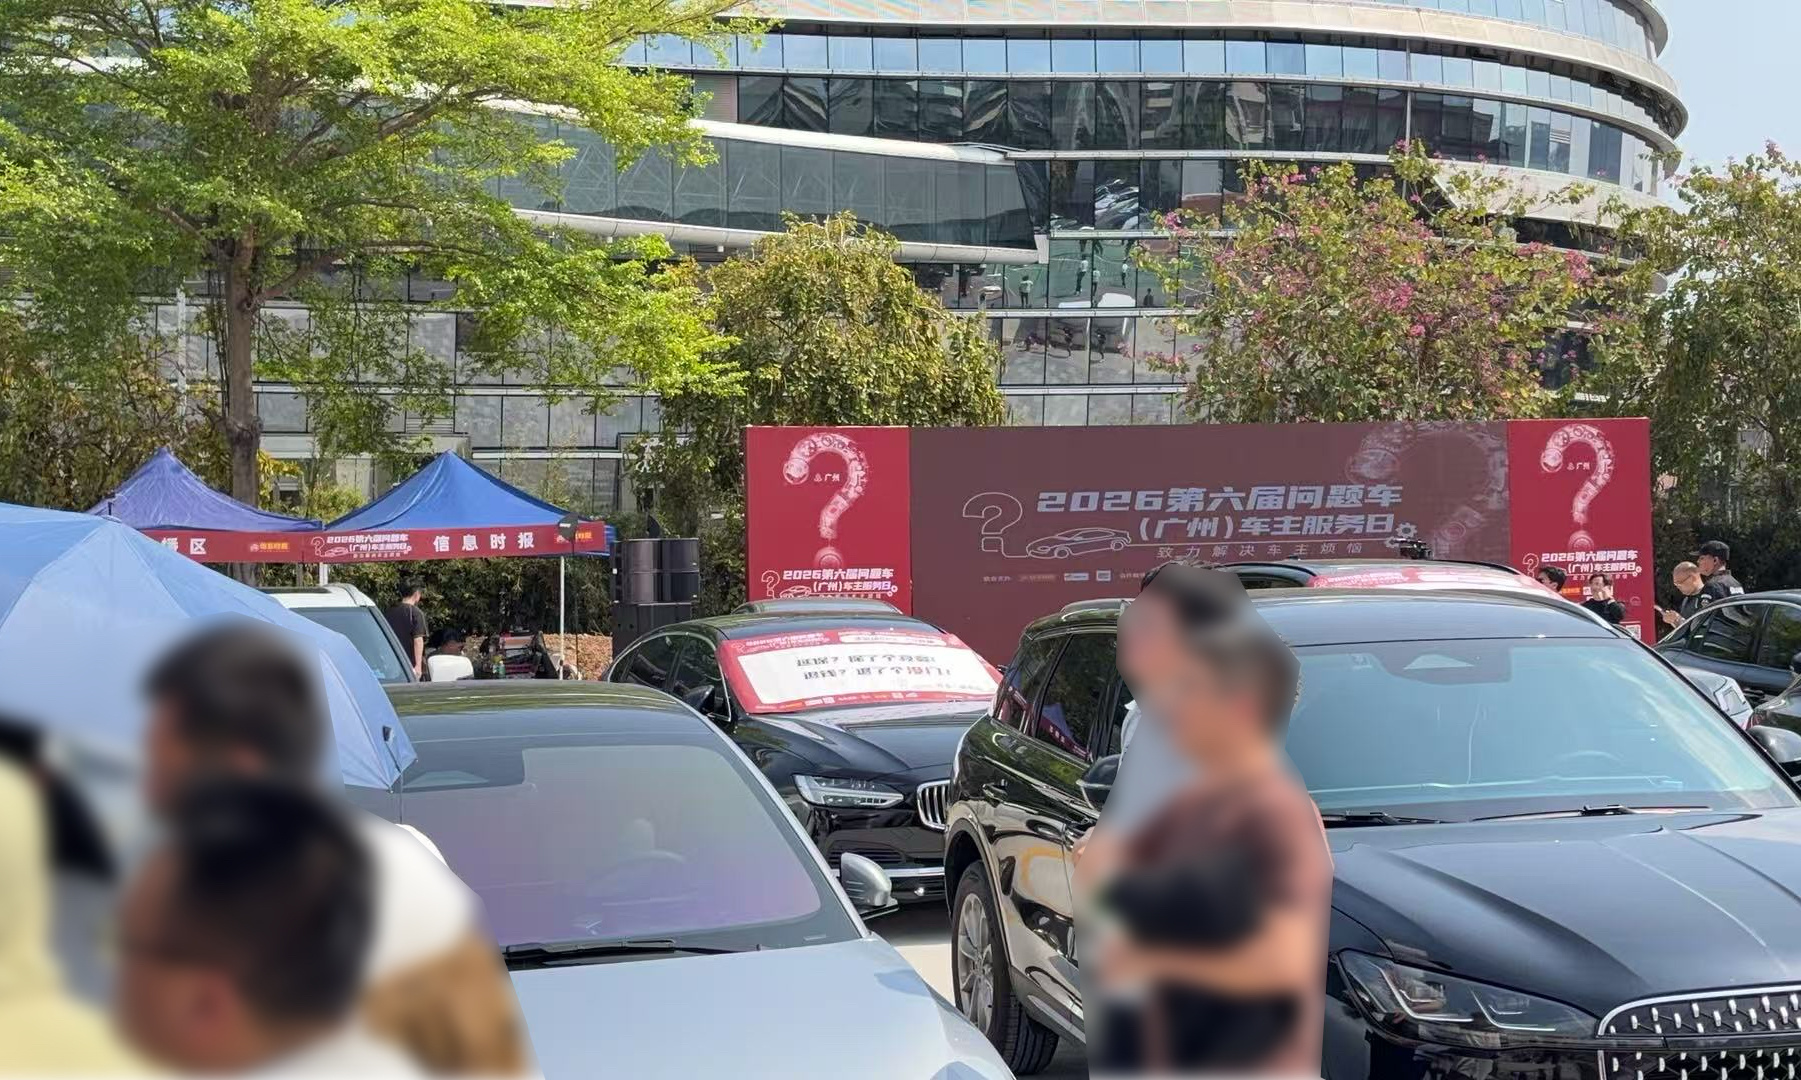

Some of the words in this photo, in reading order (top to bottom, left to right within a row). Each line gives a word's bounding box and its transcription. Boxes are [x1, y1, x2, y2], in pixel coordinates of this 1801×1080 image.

[1037, 483, 1403, 513] 2026第六届问题车
[1139, 513, 1394, 541] （广州）车主服务日
[433, 531, 534, 552] 信息时报
[1157, 542, 1363, 560] 致力解决车主烦恼
[782, 568, 894, 580] 2026第六届问题车
